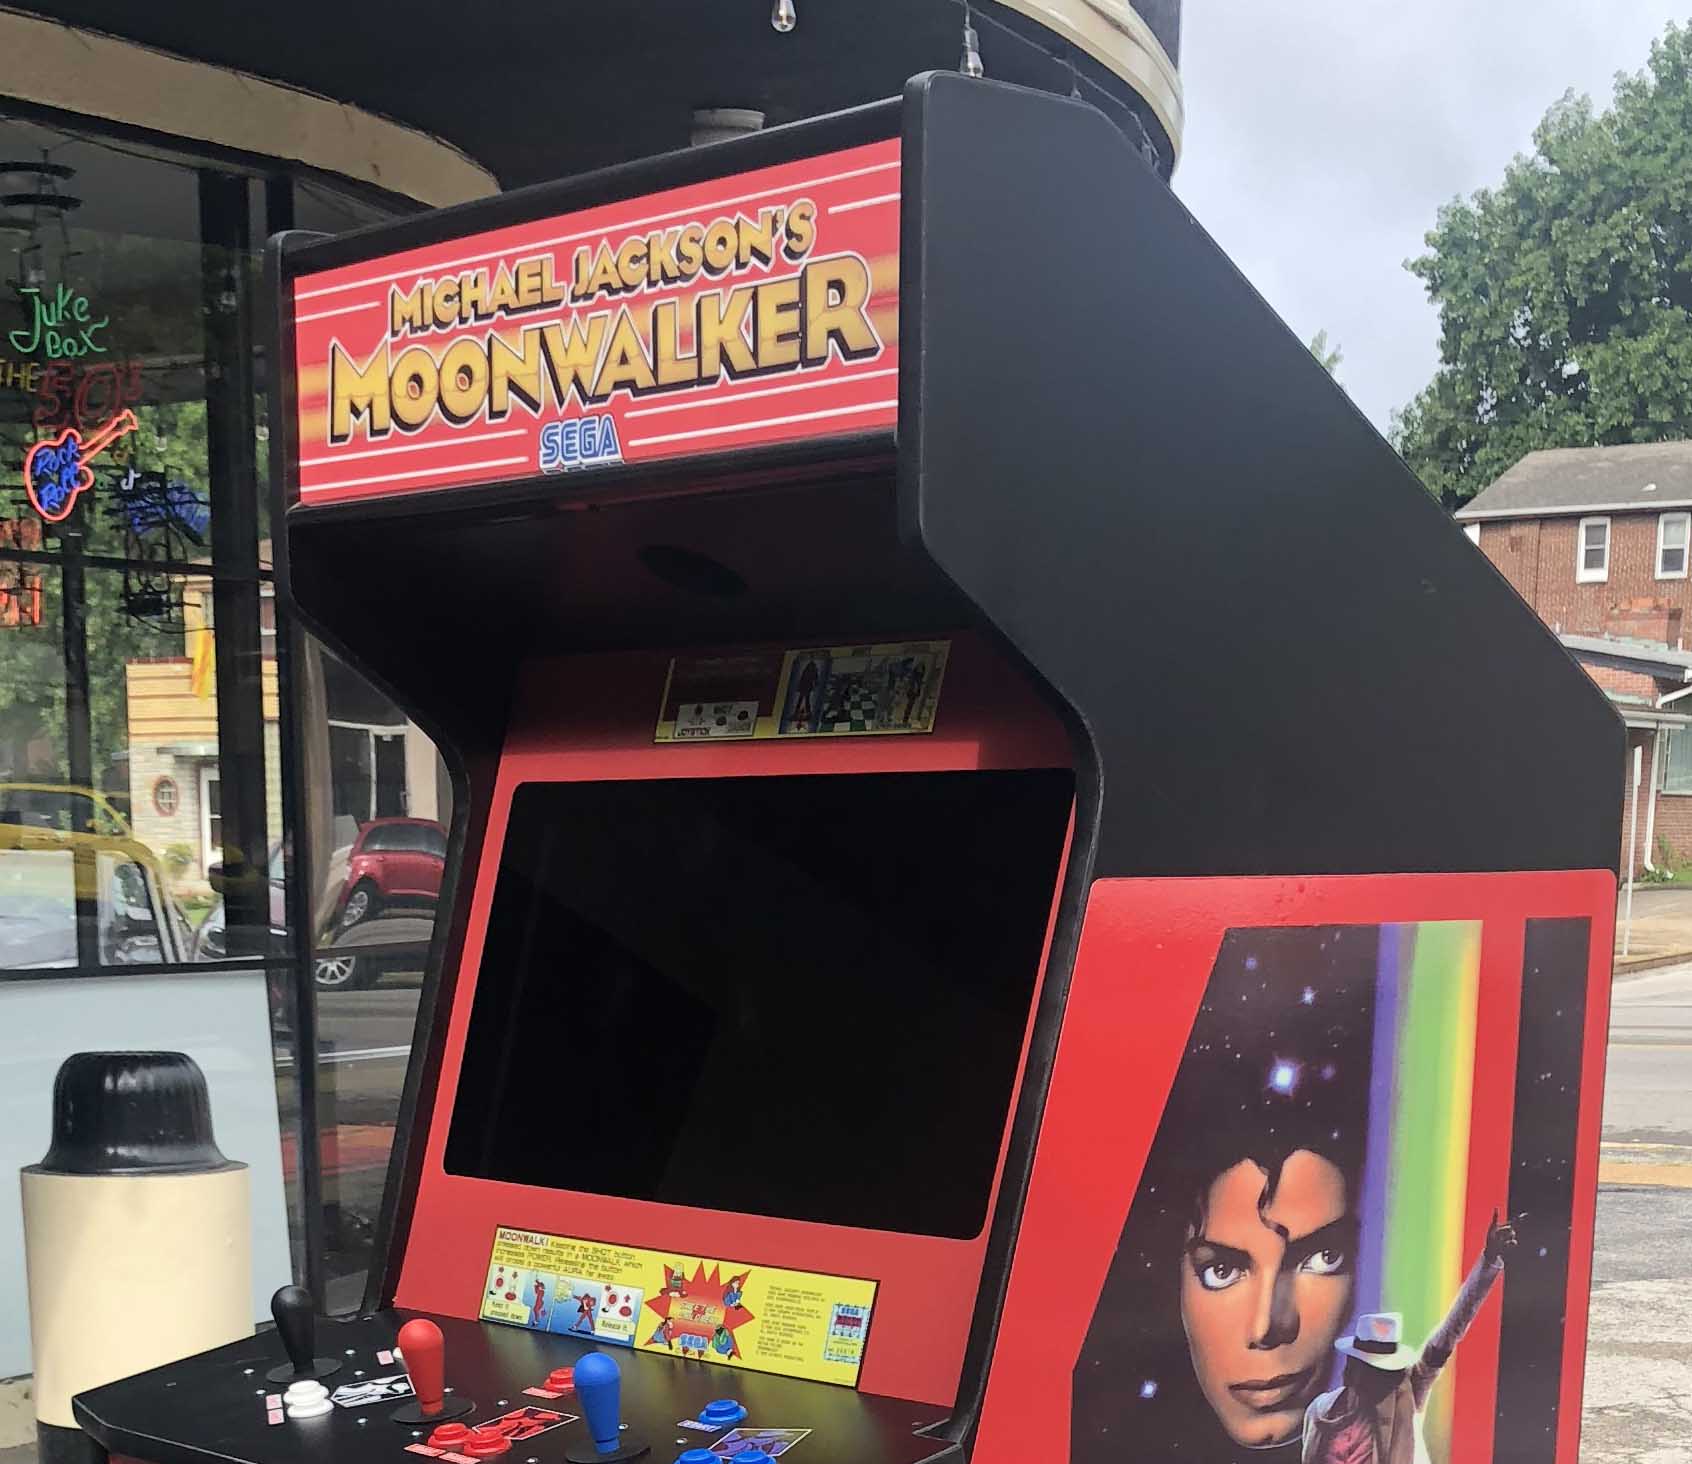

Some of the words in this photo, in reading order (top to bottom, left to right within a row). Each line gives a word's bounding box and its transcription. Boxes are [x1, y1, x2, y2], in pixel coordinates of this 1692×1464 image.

[390, 251, 568, 339] MICHAEL
[570, 198, 817, 306] JACKSON'S
[9, 283, 90, 353] Juke
[45, 316, 109, 358] Box
[328, 253, 880, 446] MOONWALKER
[539, 414, 625, 474] SEGA
